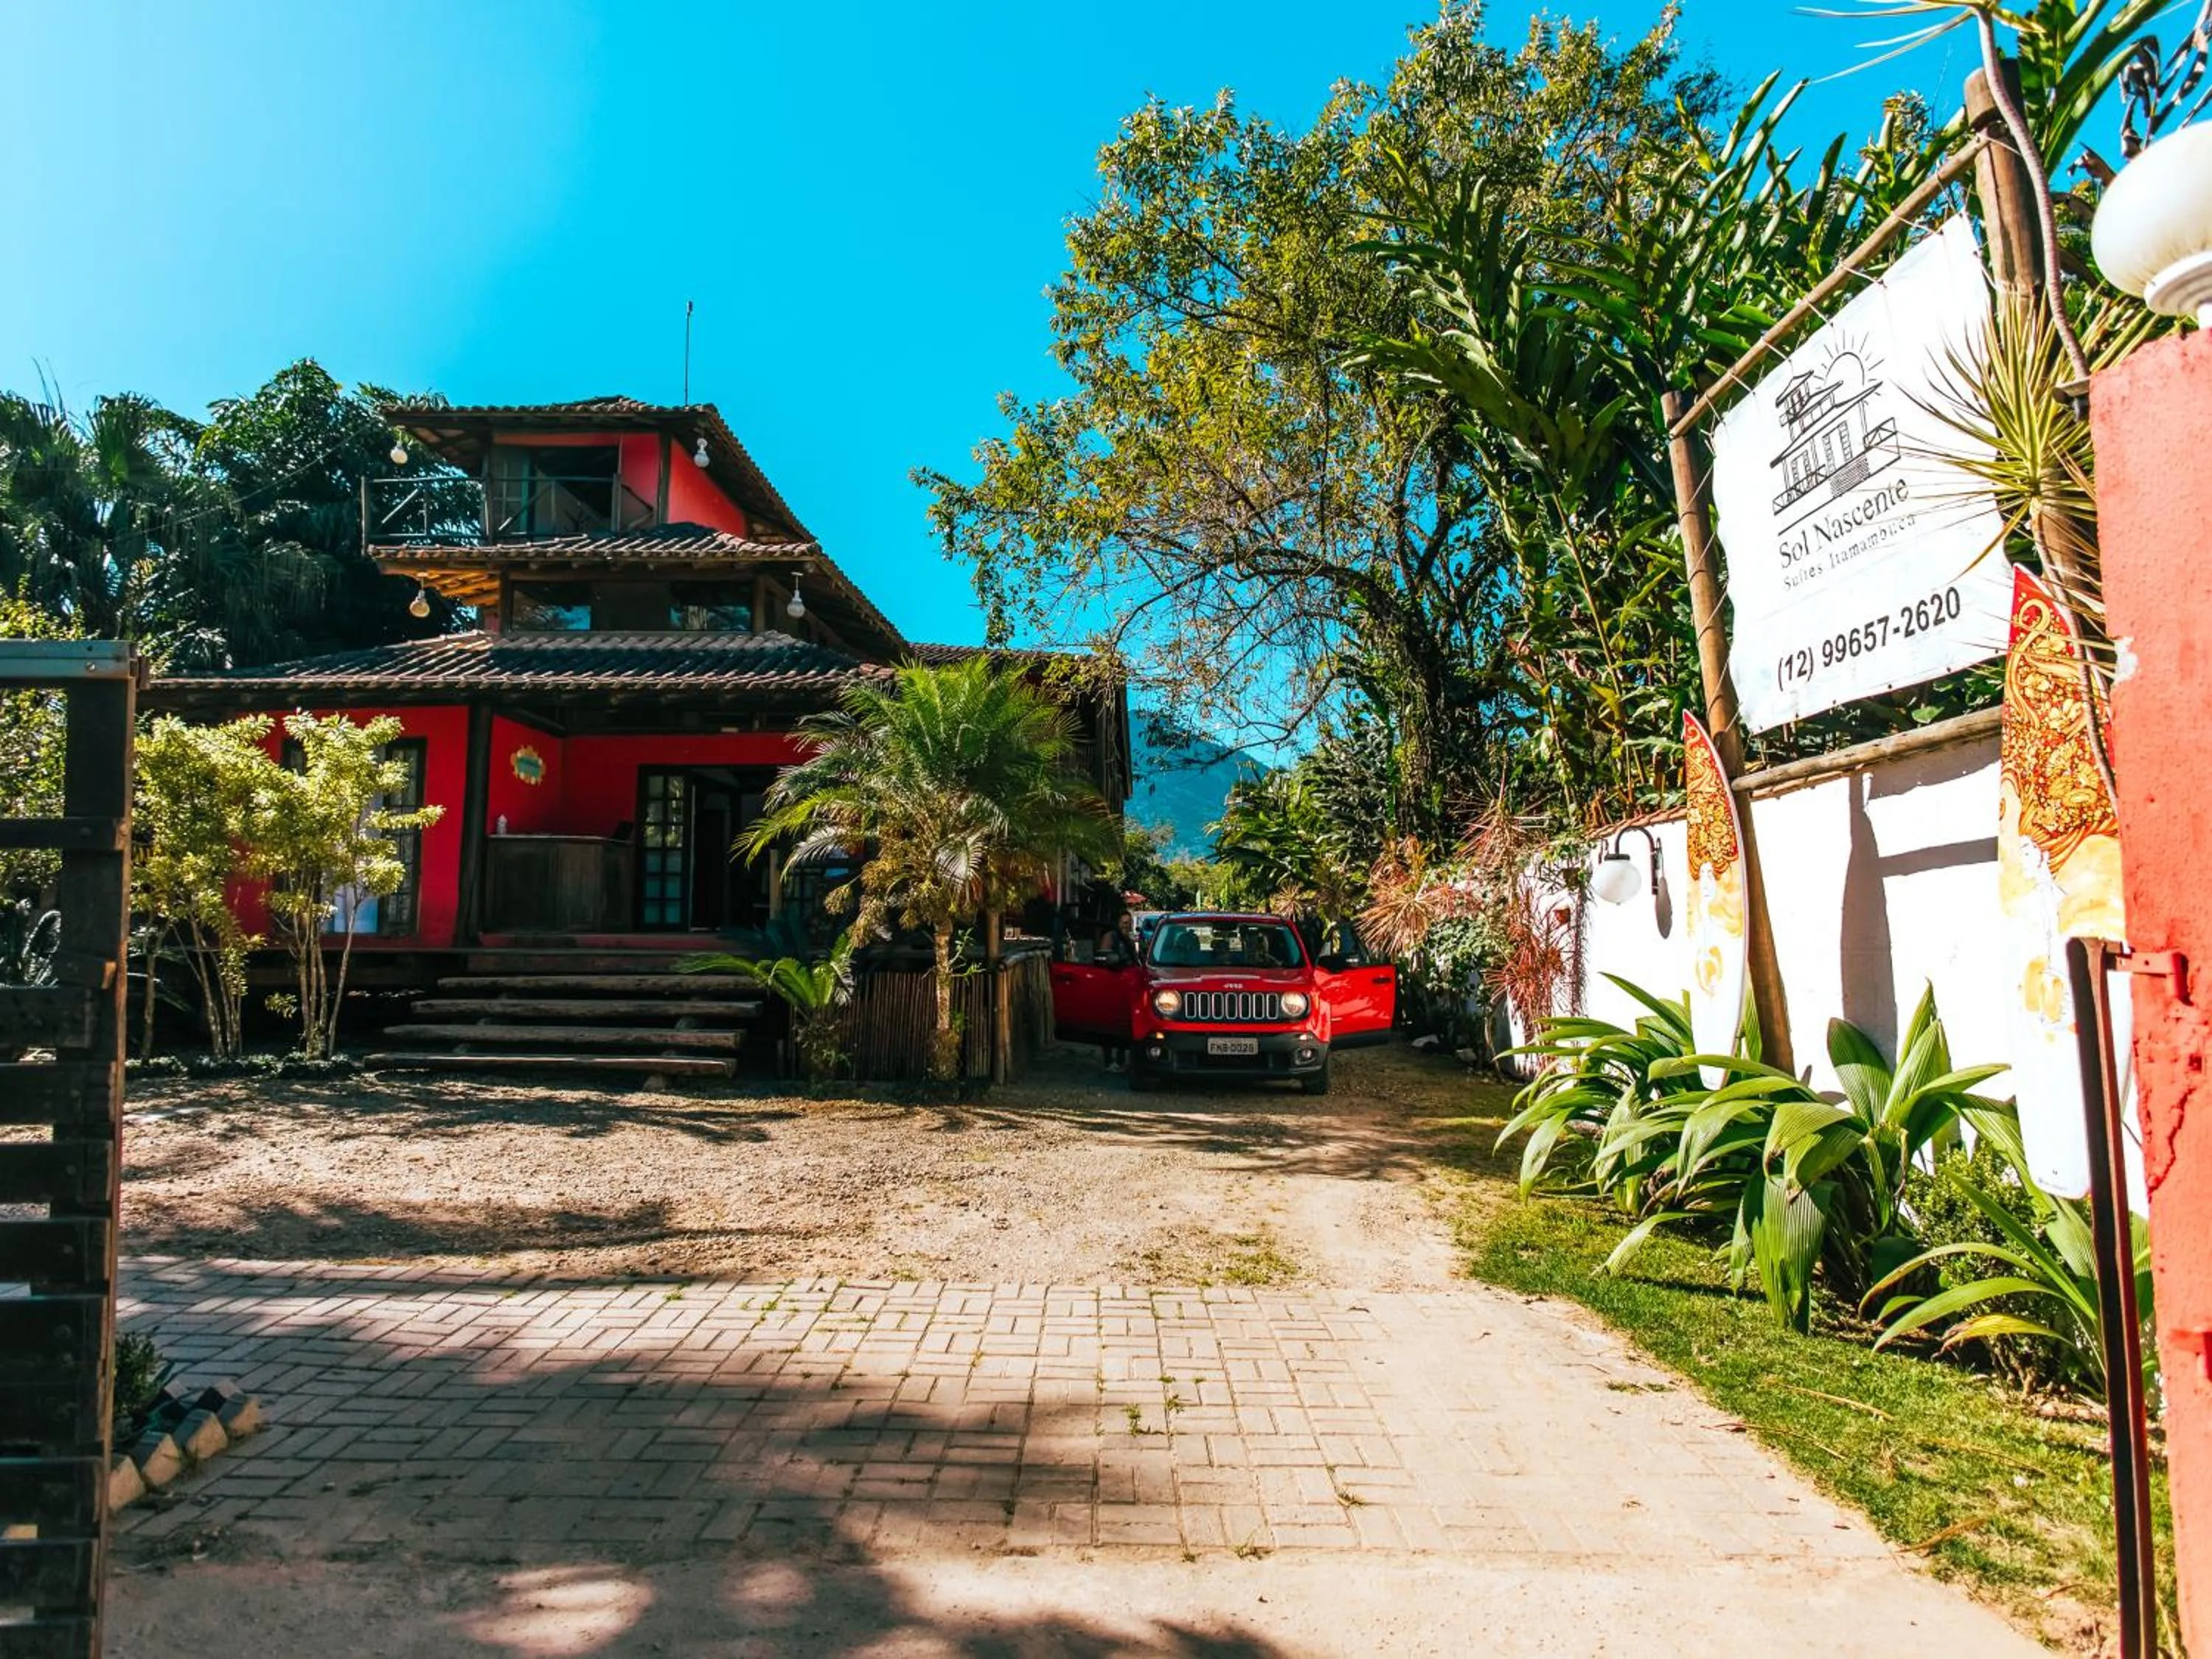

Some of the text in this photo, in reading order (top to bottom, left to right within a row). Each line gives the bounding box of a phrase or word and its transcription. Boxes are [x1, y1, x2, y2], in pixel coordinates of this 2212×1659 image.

[1779, 479, 1909, 569] Sol Nascente
[1778, 586, 1961, 692] (12) 99657-2620
